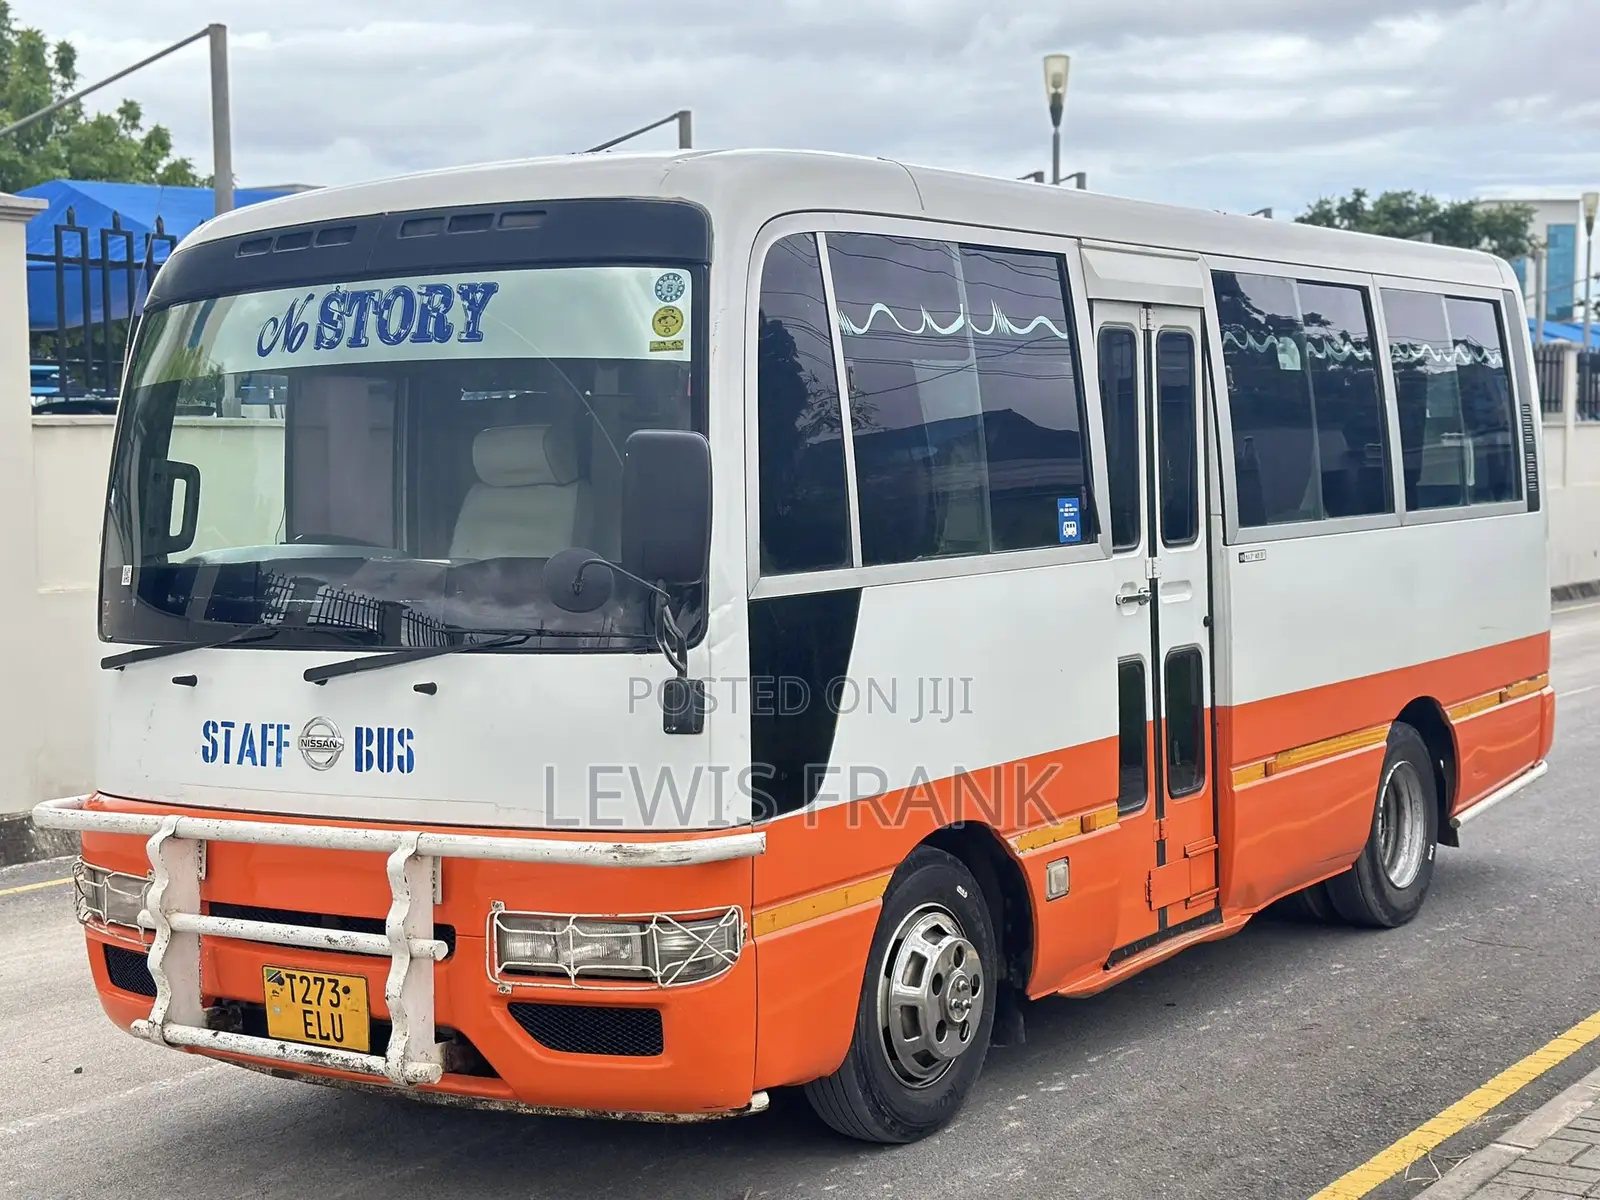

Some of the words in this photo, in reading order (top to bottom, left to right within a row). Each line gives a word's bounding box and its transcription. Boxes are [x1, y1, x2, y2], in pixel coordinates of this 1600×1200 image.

[314, 281, 499, 350] STORY
[201, 720, 291, 768] STAFF
[300, 739, 338, 749] NISSAN
[354, 726, 415, 774] BUS
[285, 973, 341, 1008] T273
[302, 1009, 344, 1043] ELU
